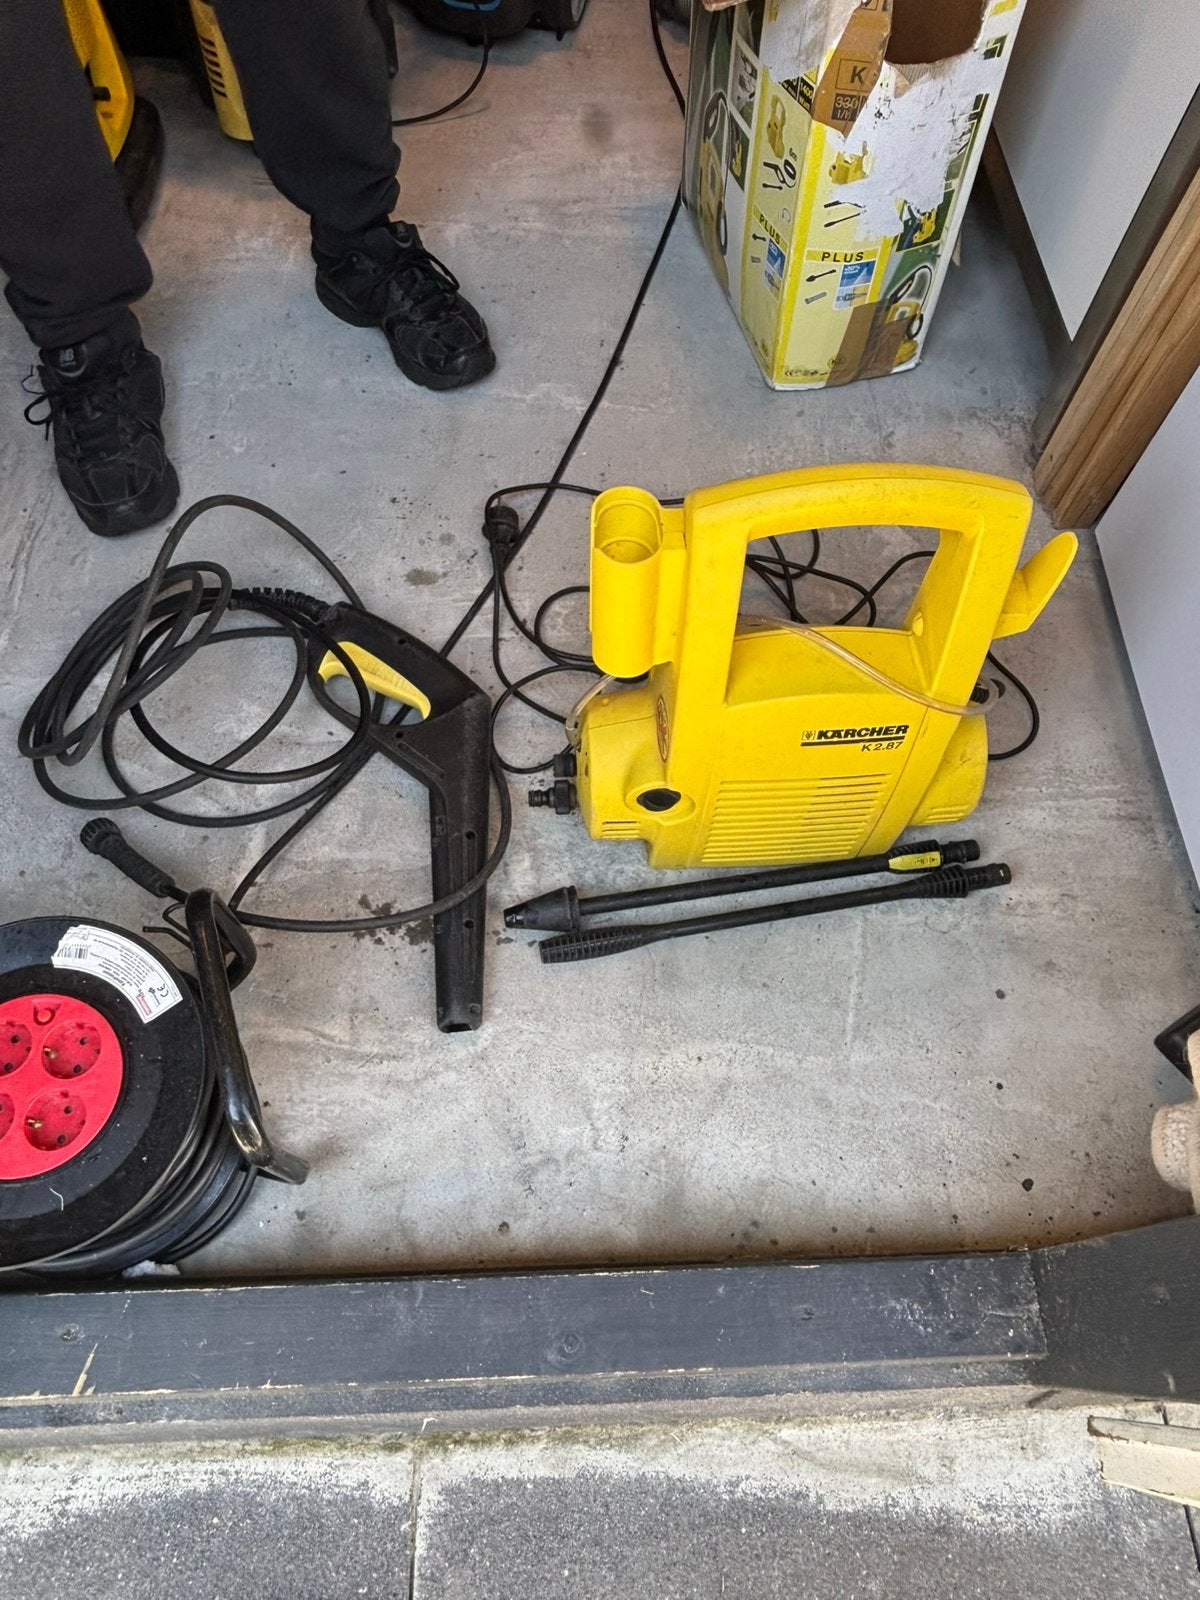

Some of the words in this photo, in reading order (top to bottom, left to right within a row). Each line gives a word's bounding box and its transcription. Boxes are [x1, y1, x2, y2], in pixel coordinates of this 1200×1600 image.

[850, 65, 866, 84] K
[759, 213, 780, 244] PLUS
[821, 251, 864, 263] PLUS
[861, 743, 872, 752] K
[873, 741, 903, 751] 2.87
